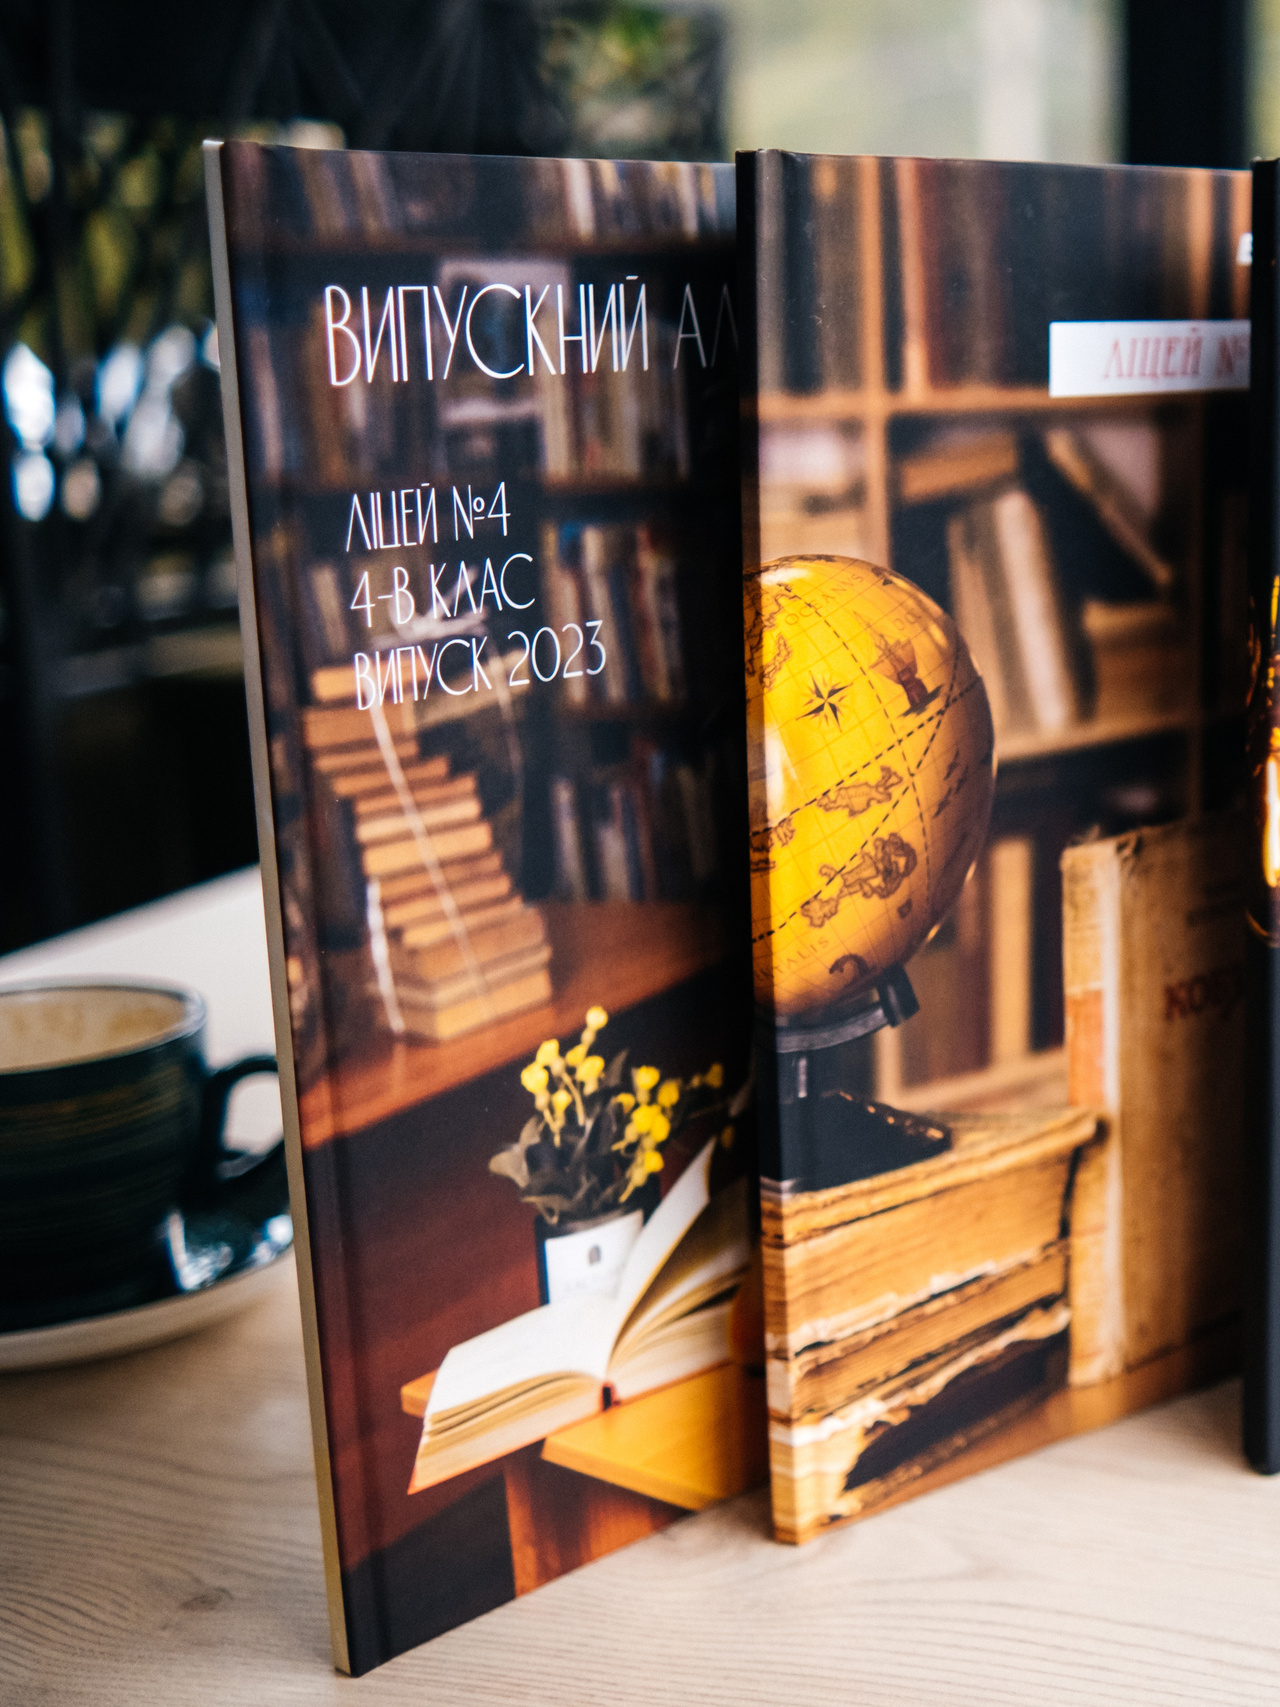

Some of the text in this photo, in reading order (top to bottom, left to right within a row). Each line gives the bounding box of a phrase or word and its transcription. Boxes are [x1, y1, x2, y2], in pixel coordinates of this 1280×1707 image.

[325, 276, 649, 387] ВИПУСКНИЙ
[346, 481, 511, 553] ЛІЦЕЙ №4
[350, 553, 536, 628] 4-В КЛАС
[353, 619, 608, 711] ВИПУСК 2023
